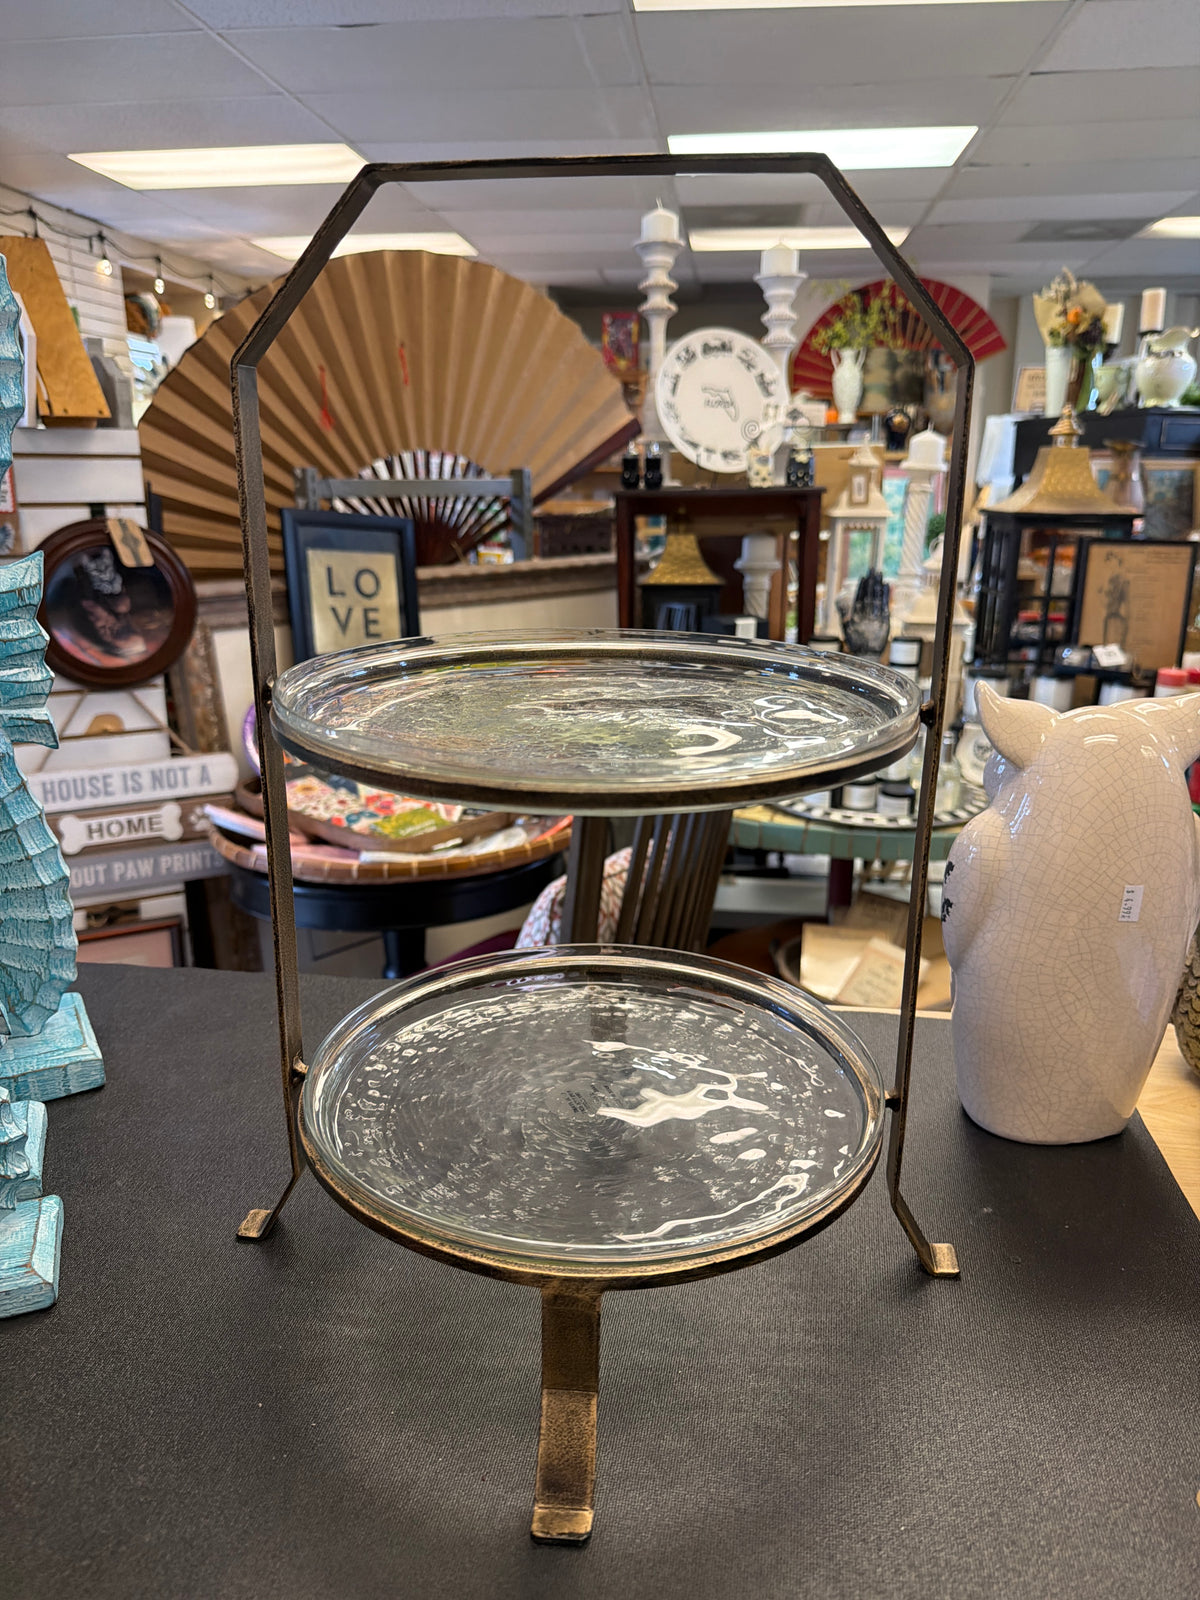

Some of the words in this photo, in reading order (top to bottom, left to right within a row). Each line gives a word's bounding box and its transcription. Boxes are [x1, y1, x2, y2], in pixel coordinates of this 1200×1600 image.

[41, 772, 116, 804] HOUSE
[122, 770, 144, 795] IS
[151, 765, 191, 791] NOT
[200, 764, 212, 786] A
[86, 814, 165, 841] HOME
[113, 856, 155, 883] PAW
[160, 849, 224, 875] PRINTS
